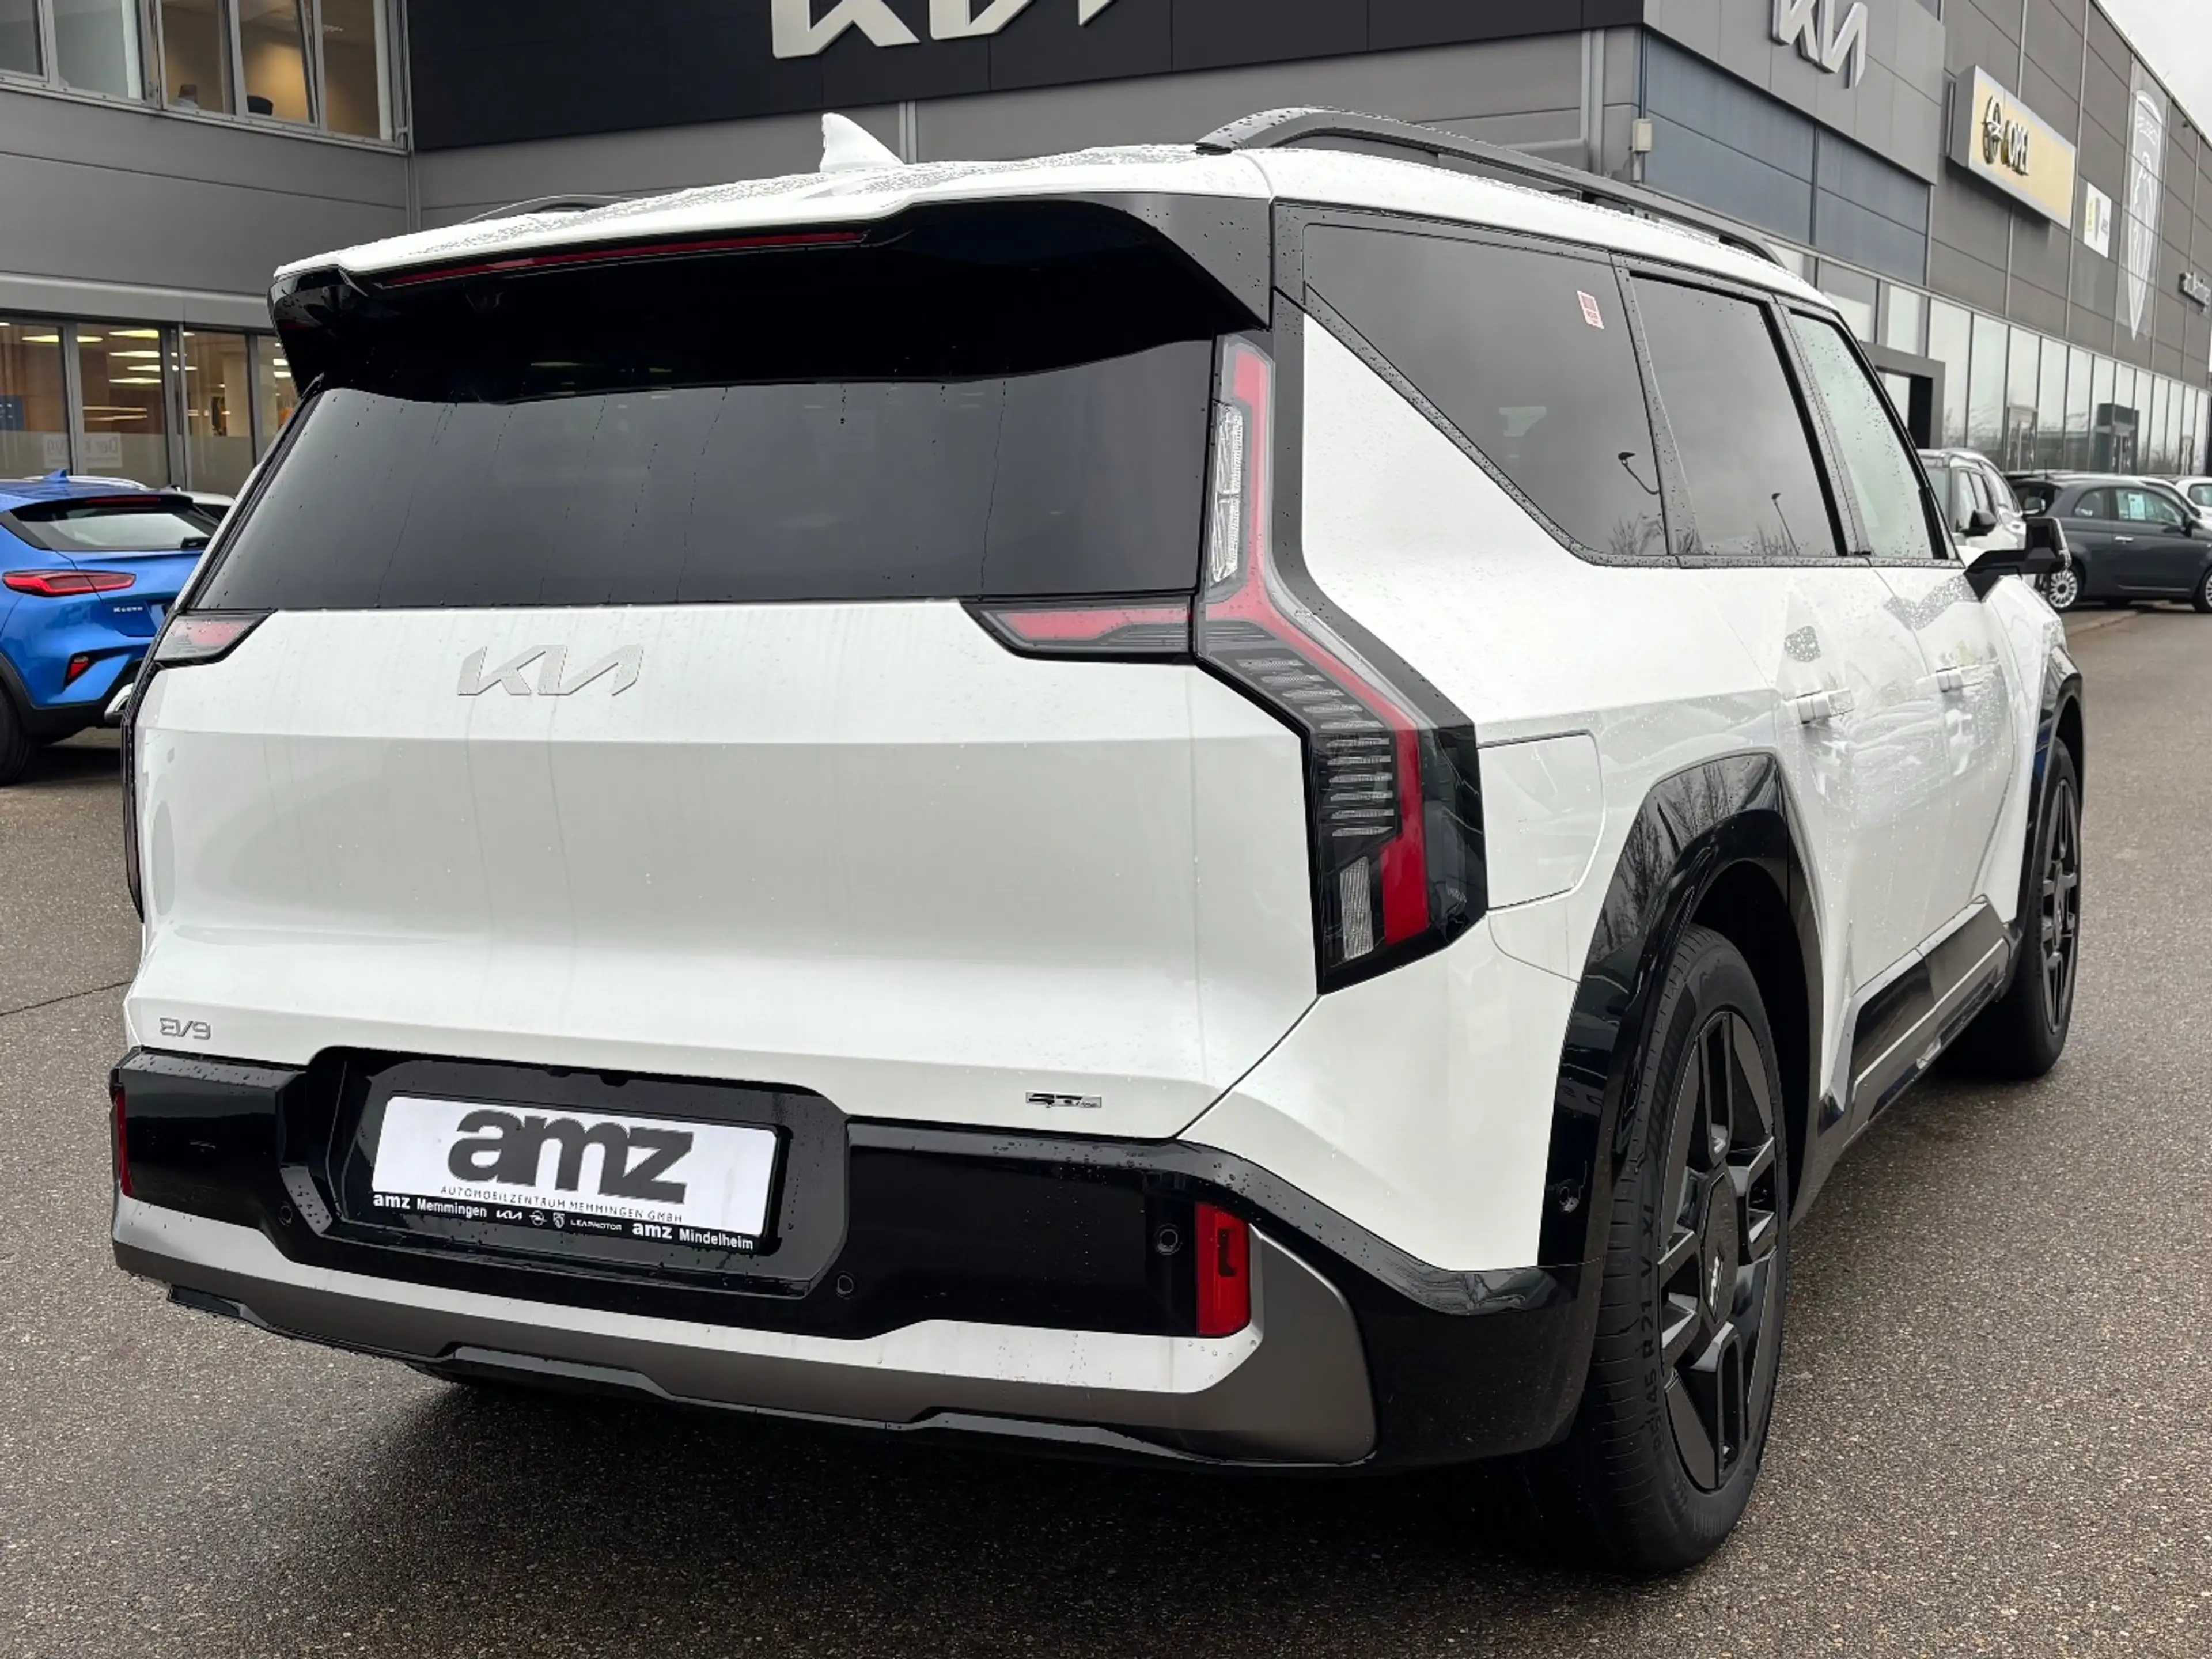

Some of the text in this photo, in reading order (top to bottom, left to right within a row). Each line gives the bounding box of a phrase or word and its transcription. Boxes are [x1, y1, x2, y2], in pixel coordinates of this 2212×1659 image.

[457, 643, 644, 697] KIA
[159, 1017, 211, 1040] EV9
[448, 1109, 694, 1205] amz
[373, 1194, 487, 1219] amz Memmingen
[440, 1185, 682, 1223] AUTOMOBILZENTRUM MEMMINGEN GMBH
[631, 1222, 753, 1250] amz Mindelheim
